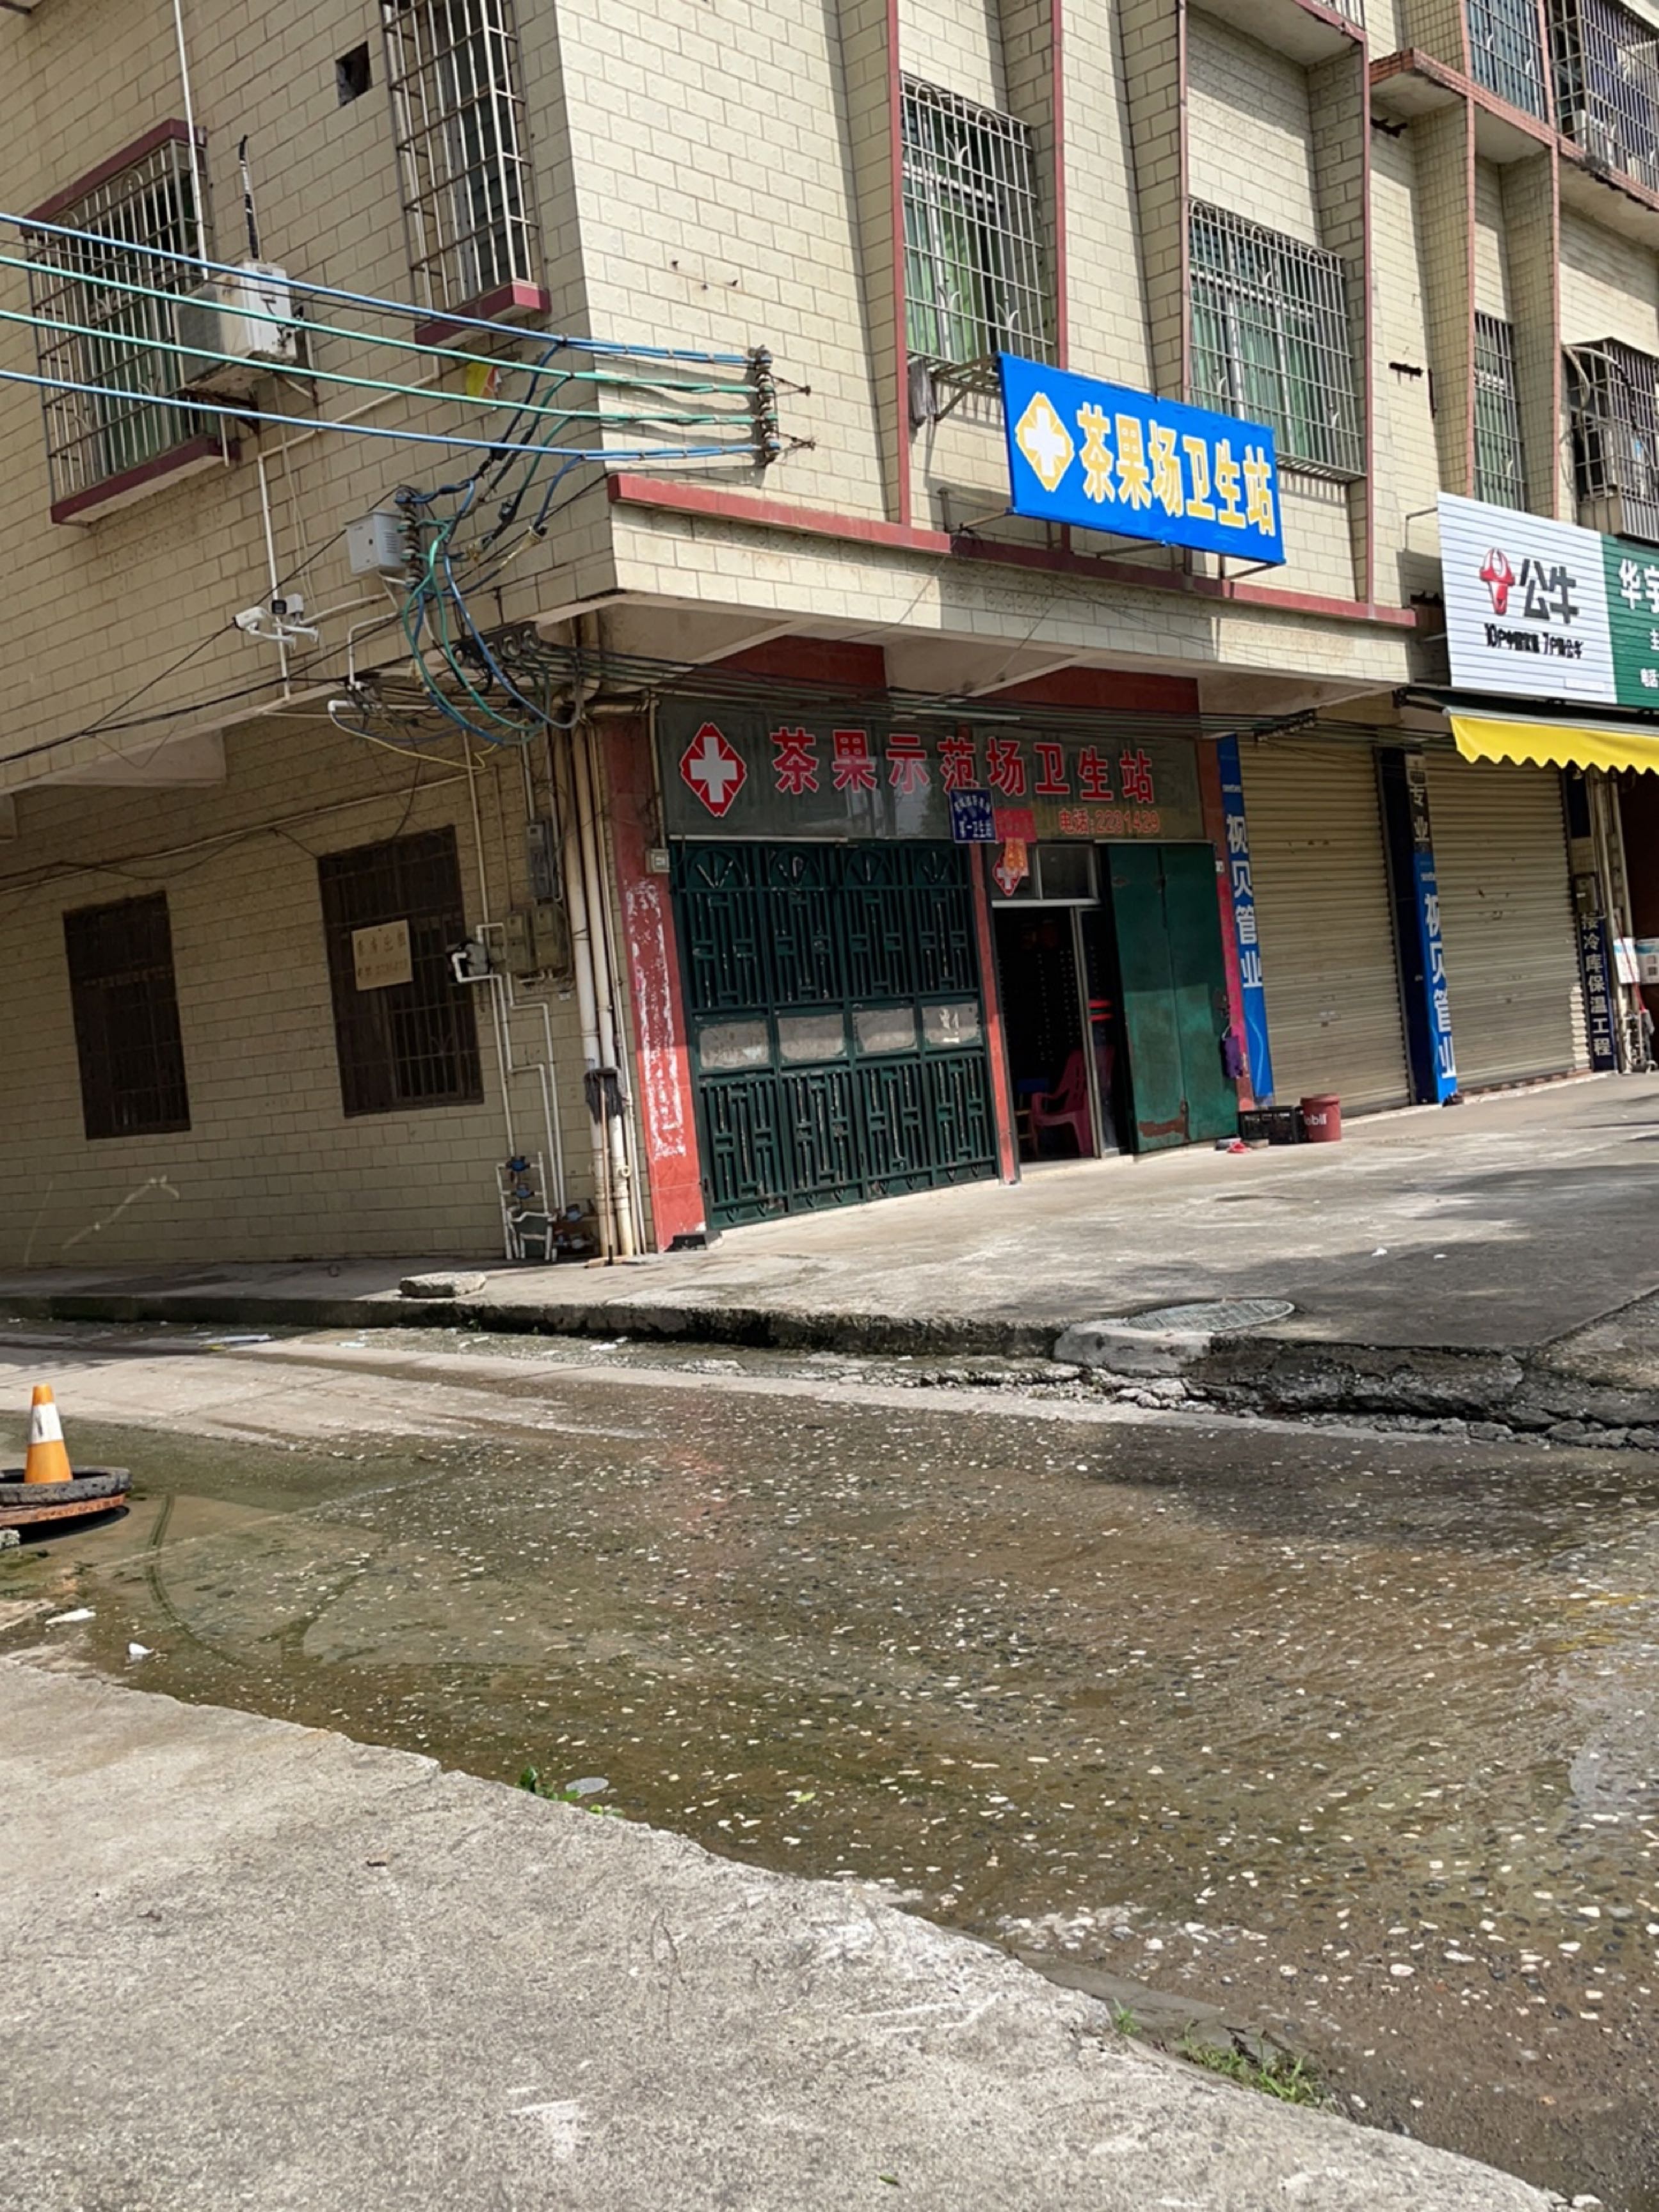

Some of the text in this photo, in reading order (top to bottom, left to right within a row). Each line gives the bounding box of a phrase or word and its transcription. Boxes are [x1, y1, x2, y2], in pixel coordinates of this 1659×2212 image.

[1077, 401, 1276, 537] 茶果场卫生站
[1519, 558, 1579, 624] 公牛
[771, 727, 1153, 804] 茶果示范场卫生站
